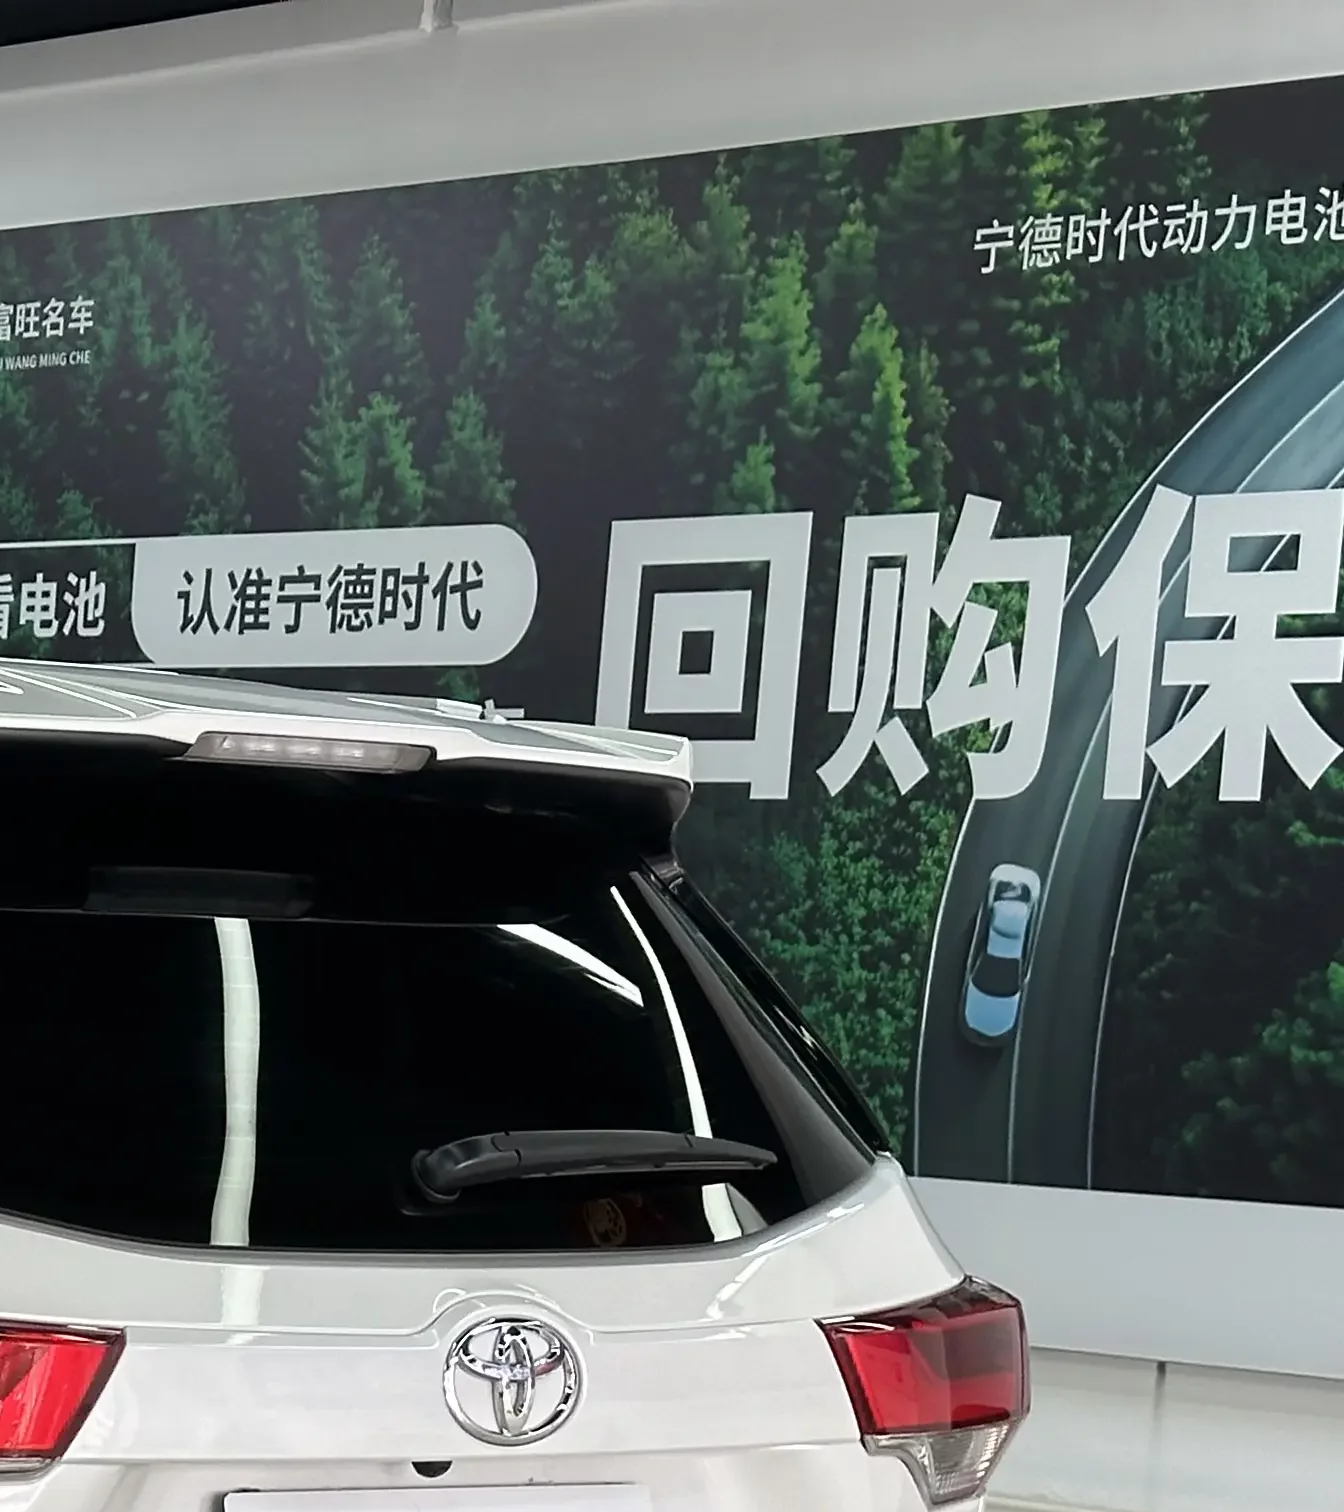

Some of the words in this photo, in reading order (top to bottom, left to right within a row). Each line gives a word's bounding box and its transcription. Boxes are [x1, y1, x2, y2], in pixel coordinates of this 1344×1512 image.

[5, 355, 37, 371] WANG
[39, 352, 68, 368] MING
[70, 349, 91, 366] CHE
[176, 559, 484, 635] 认准宁德时代
[594, 485, 1344, 801] 回购保
